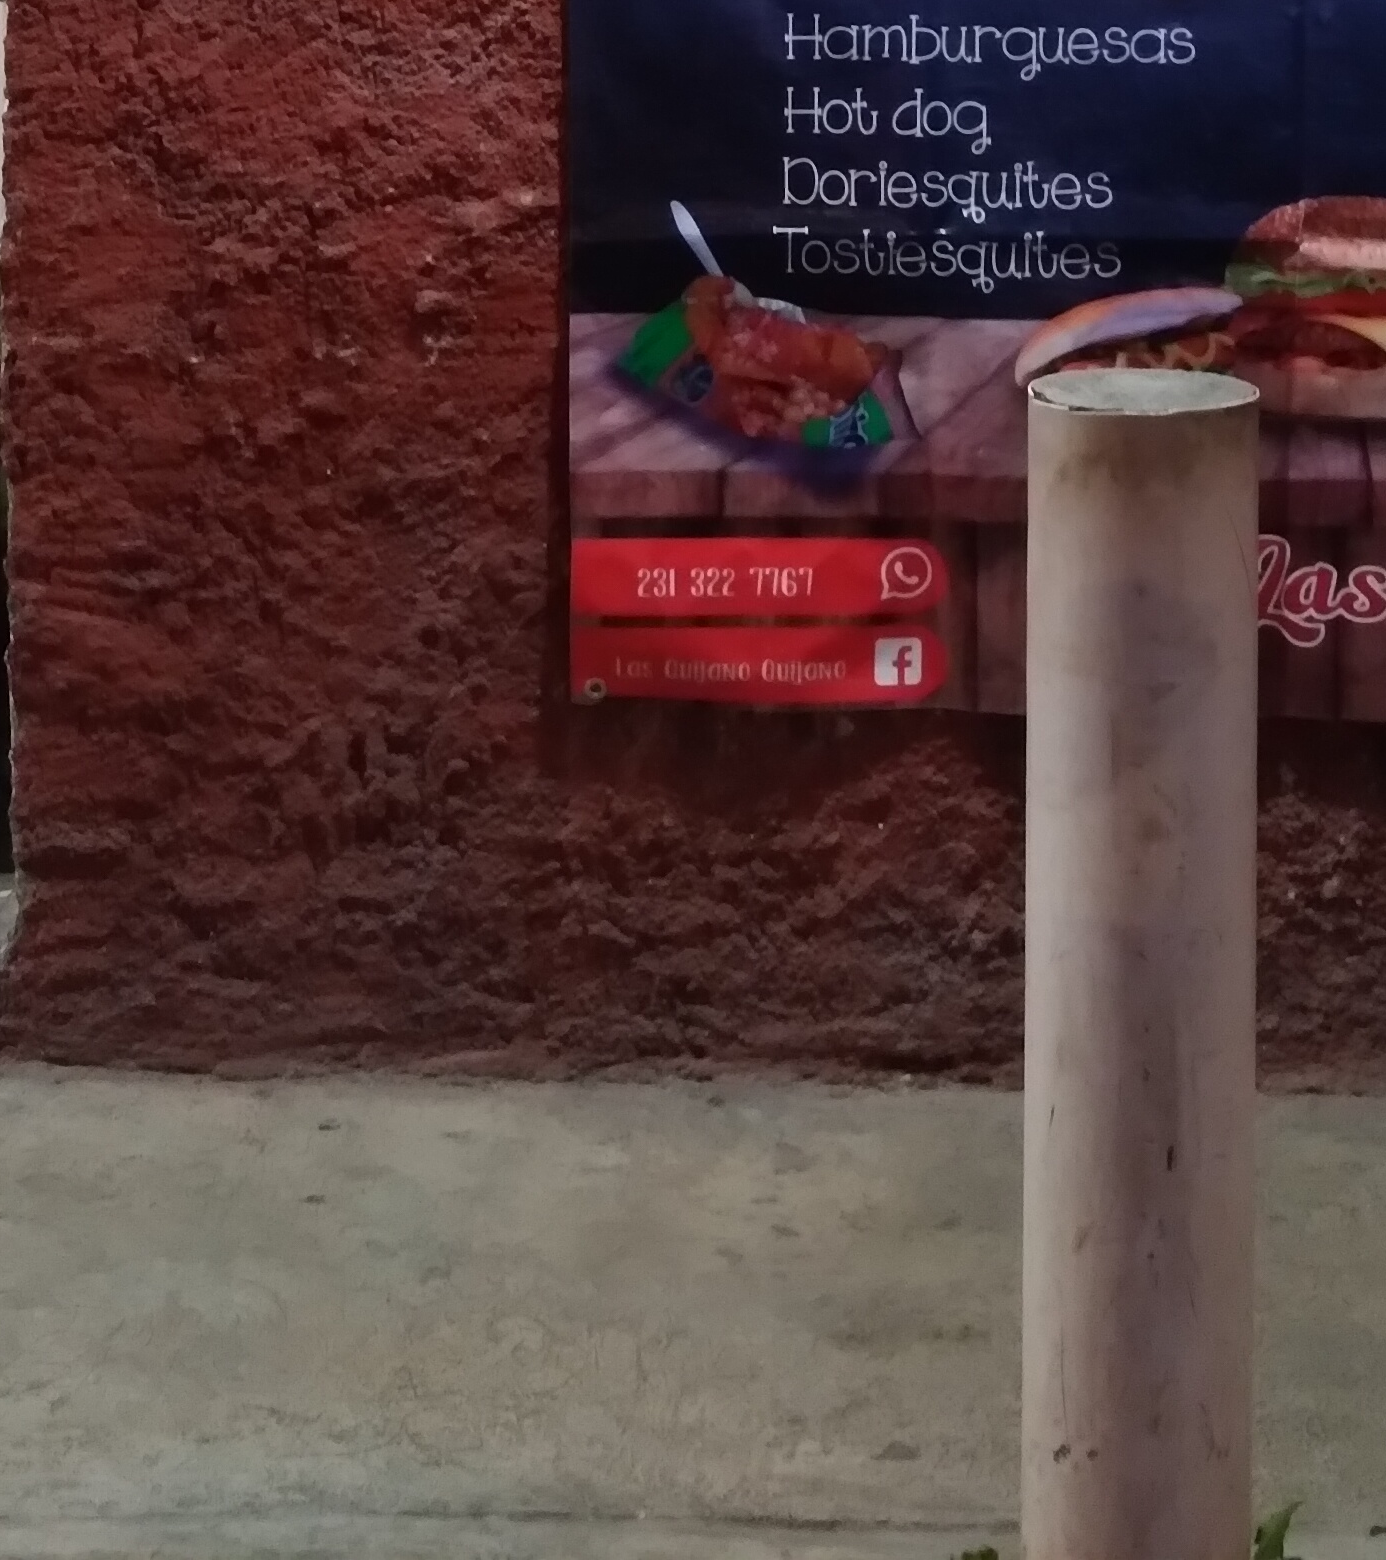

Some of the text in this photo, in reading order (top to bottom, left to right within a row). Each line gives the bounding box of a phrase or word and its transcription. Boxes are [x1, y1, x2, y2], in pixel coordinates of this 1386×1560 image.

[784, 13, 1196, 81] Hamburguesas
[784, 86, 991, 155] Hot dog
[782, 156, 1113, 224] Doriesquites
[773, 225, 1122, 294] Tostiesquites
[637, 566, 814, 598] 231 322 7767
